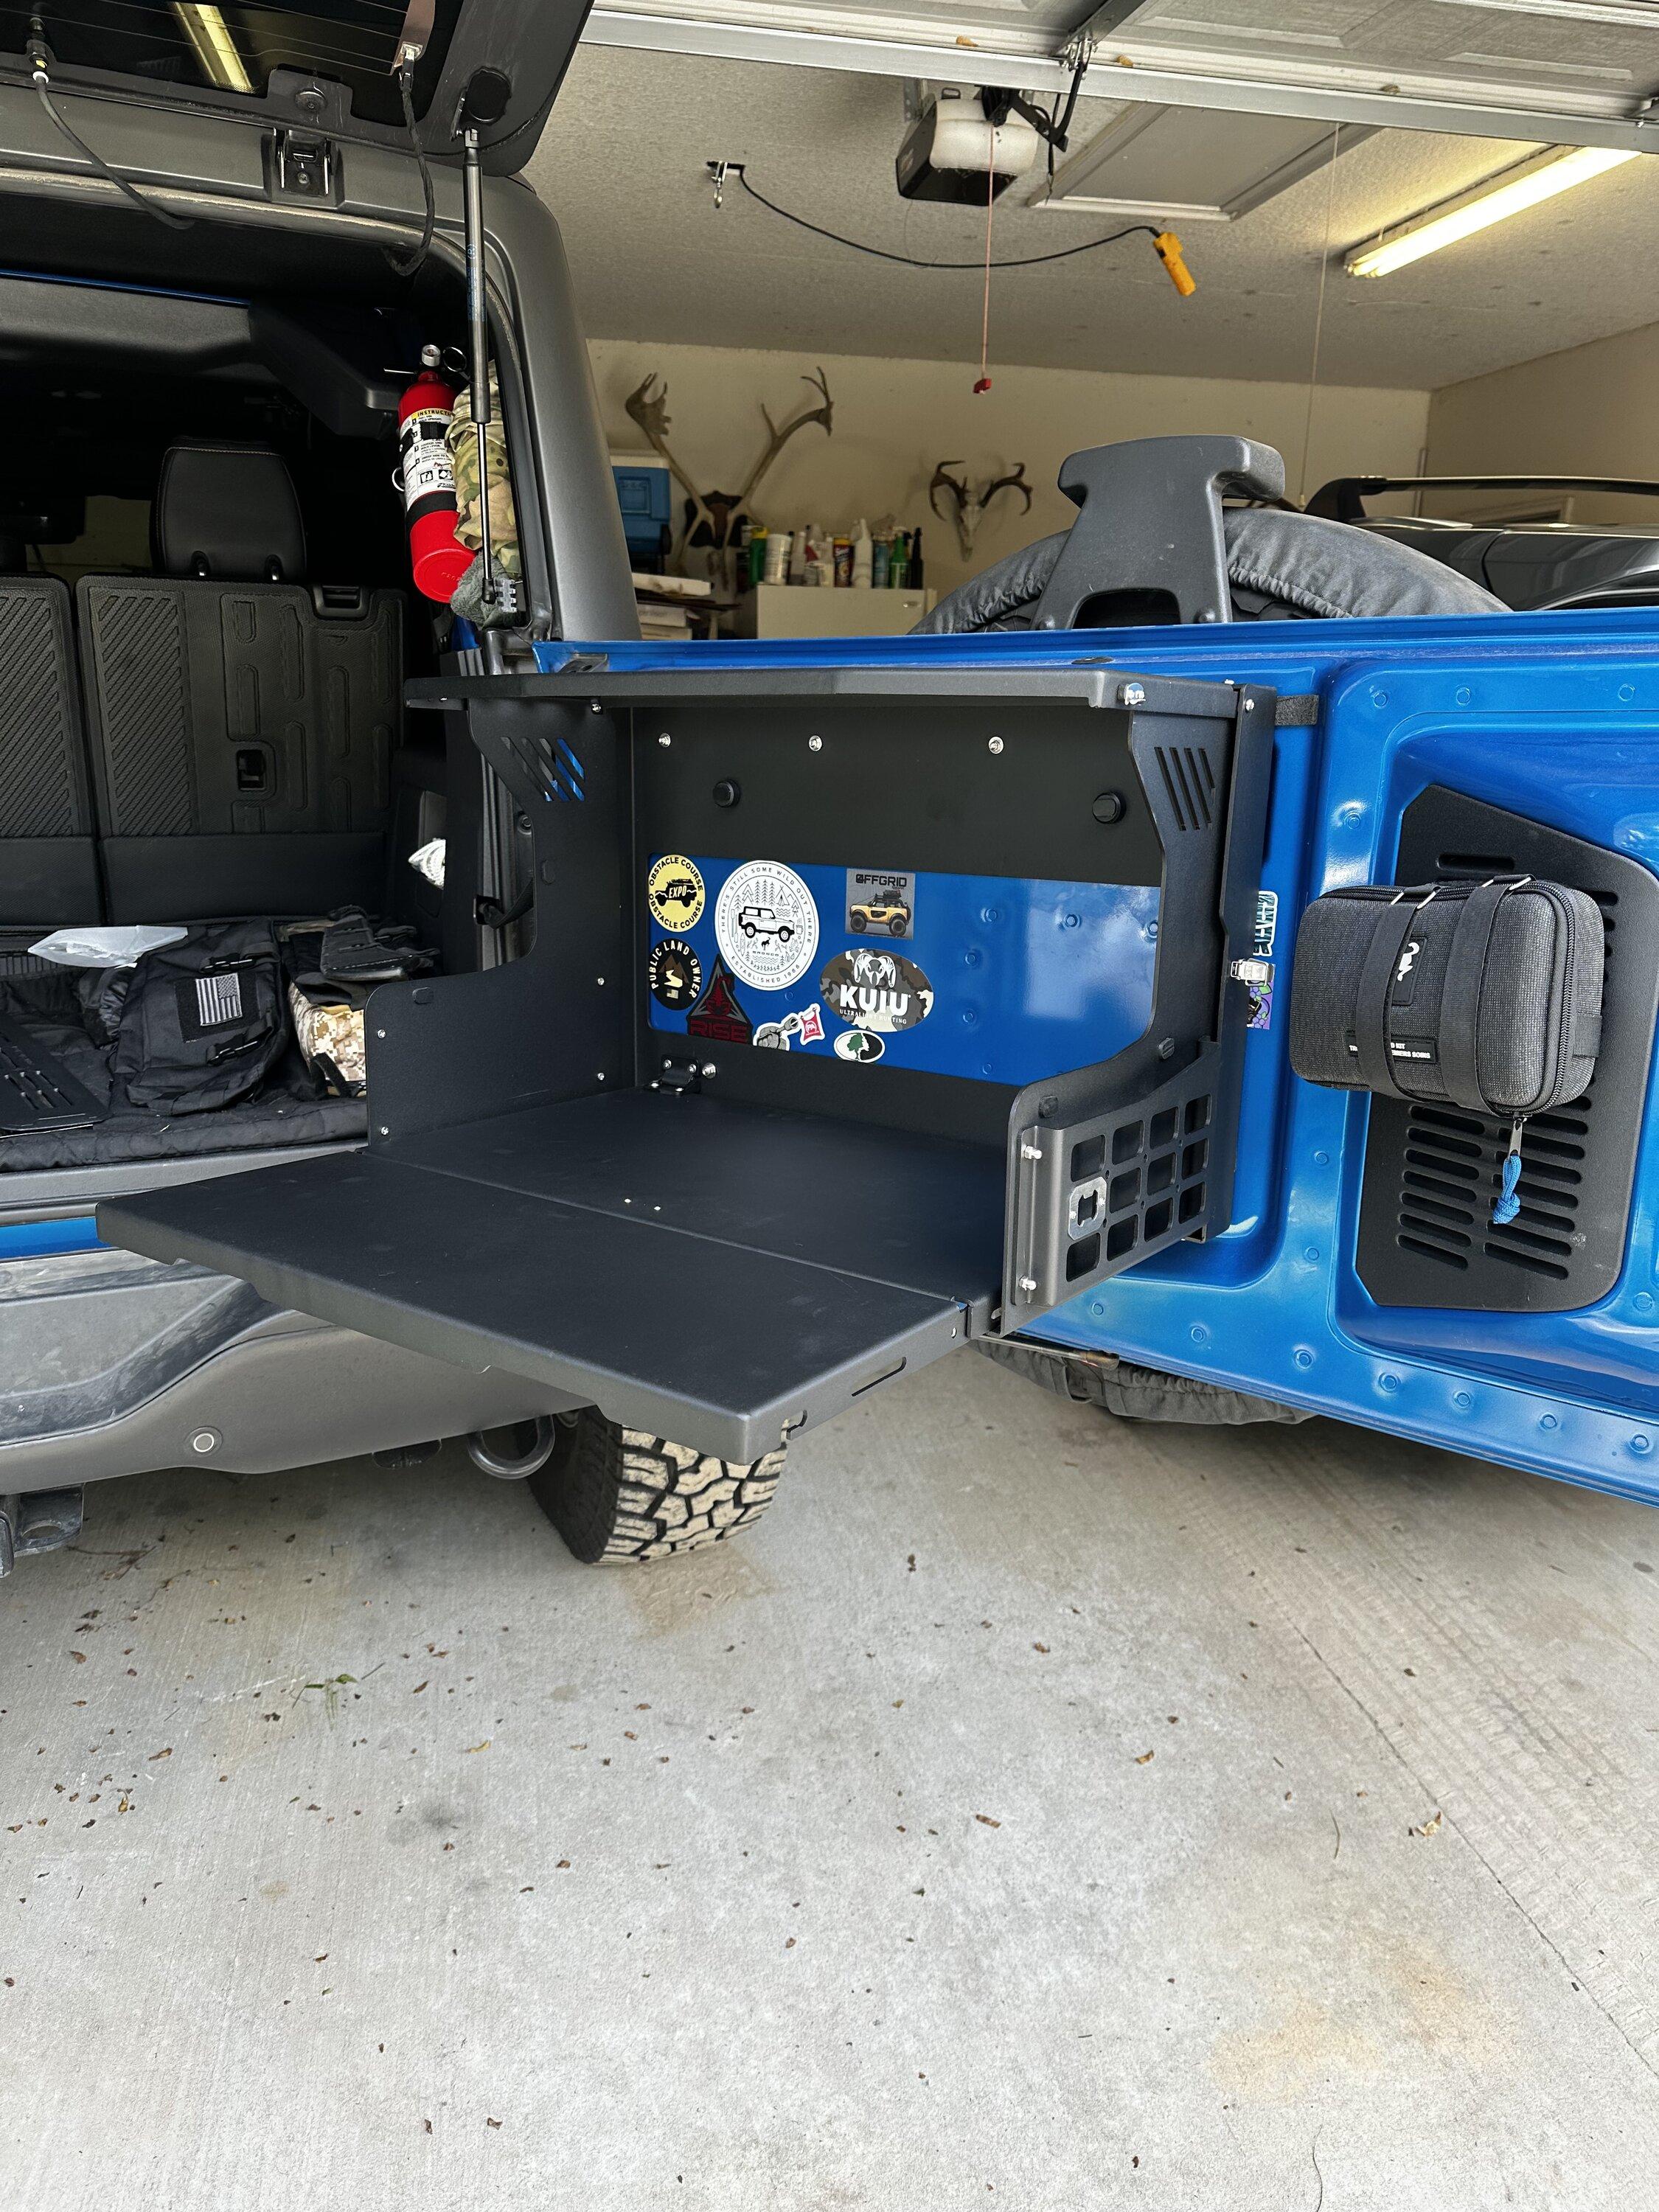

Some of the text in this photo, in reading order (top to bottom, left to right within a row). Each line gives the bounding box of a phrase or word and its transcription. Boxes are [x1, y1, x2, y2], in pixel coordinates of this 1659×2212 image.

[649, 857, 703, 891] OBSTACLE COURSE
[855, 874, 907, 887] OFFGRID
[668, 886, 687, 899] EXPO
[721, 894, 730, 933] THERE'S
[729, 872, 748, 891] STILL
[776, 870, 795, 885] WILD
[796, 888, 808, 905] OUT
[649, 893, 703, 929] OBSTACLE COURSE
[649, 940, 701, 998] PUBLIC LAND OWNER
[731, 956, 781, 983] ESTABLISHED
[840, 984, 908, 1016] KUIU
[690, 1019, 747, 1043] RISE
[839, 1009, 907, 1025] ULTRALIGHT HUNTING
